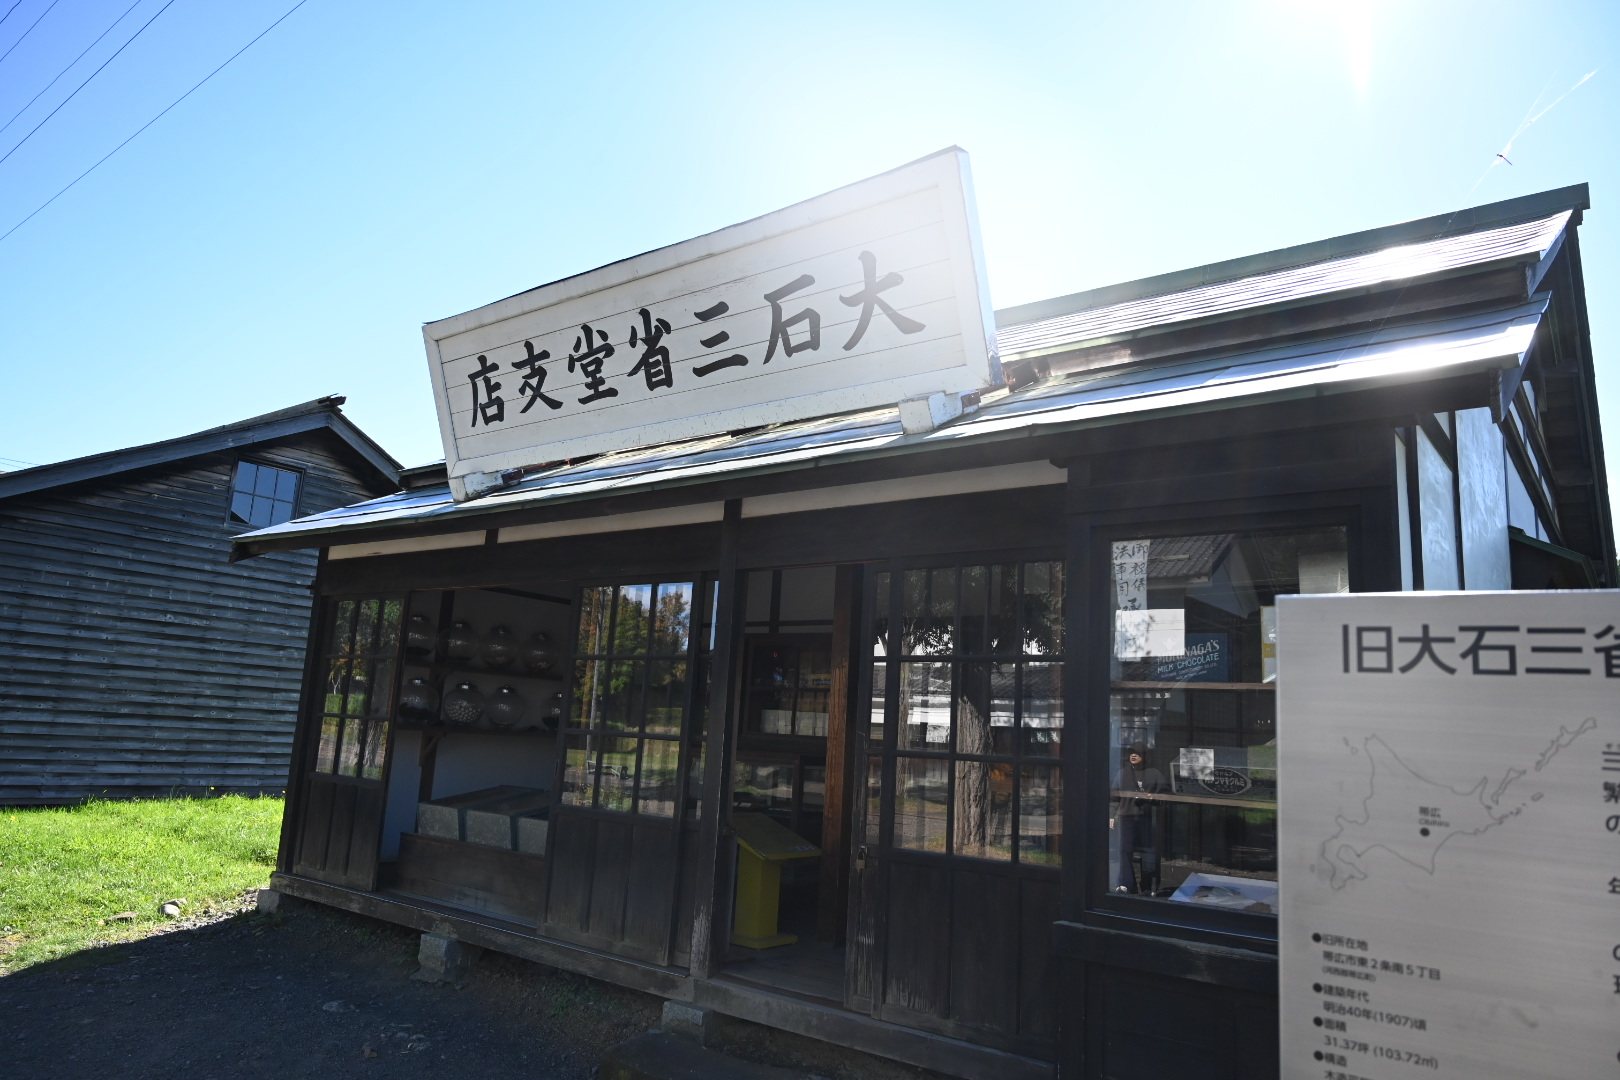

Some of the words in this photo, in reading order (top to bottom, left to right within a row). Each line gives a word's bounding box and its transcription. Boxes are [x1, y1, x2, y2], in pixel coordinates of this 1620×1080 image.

[468, 250, 927, 429] 大石三省堂支店
[1157, 663, 1174, 674] MILK
[1177, 652, 1220, 669] CHOCOLATE
[1322, 933, 1368, 951] 旧所在地
[1324, 1017, 1347, 1032] 面積
